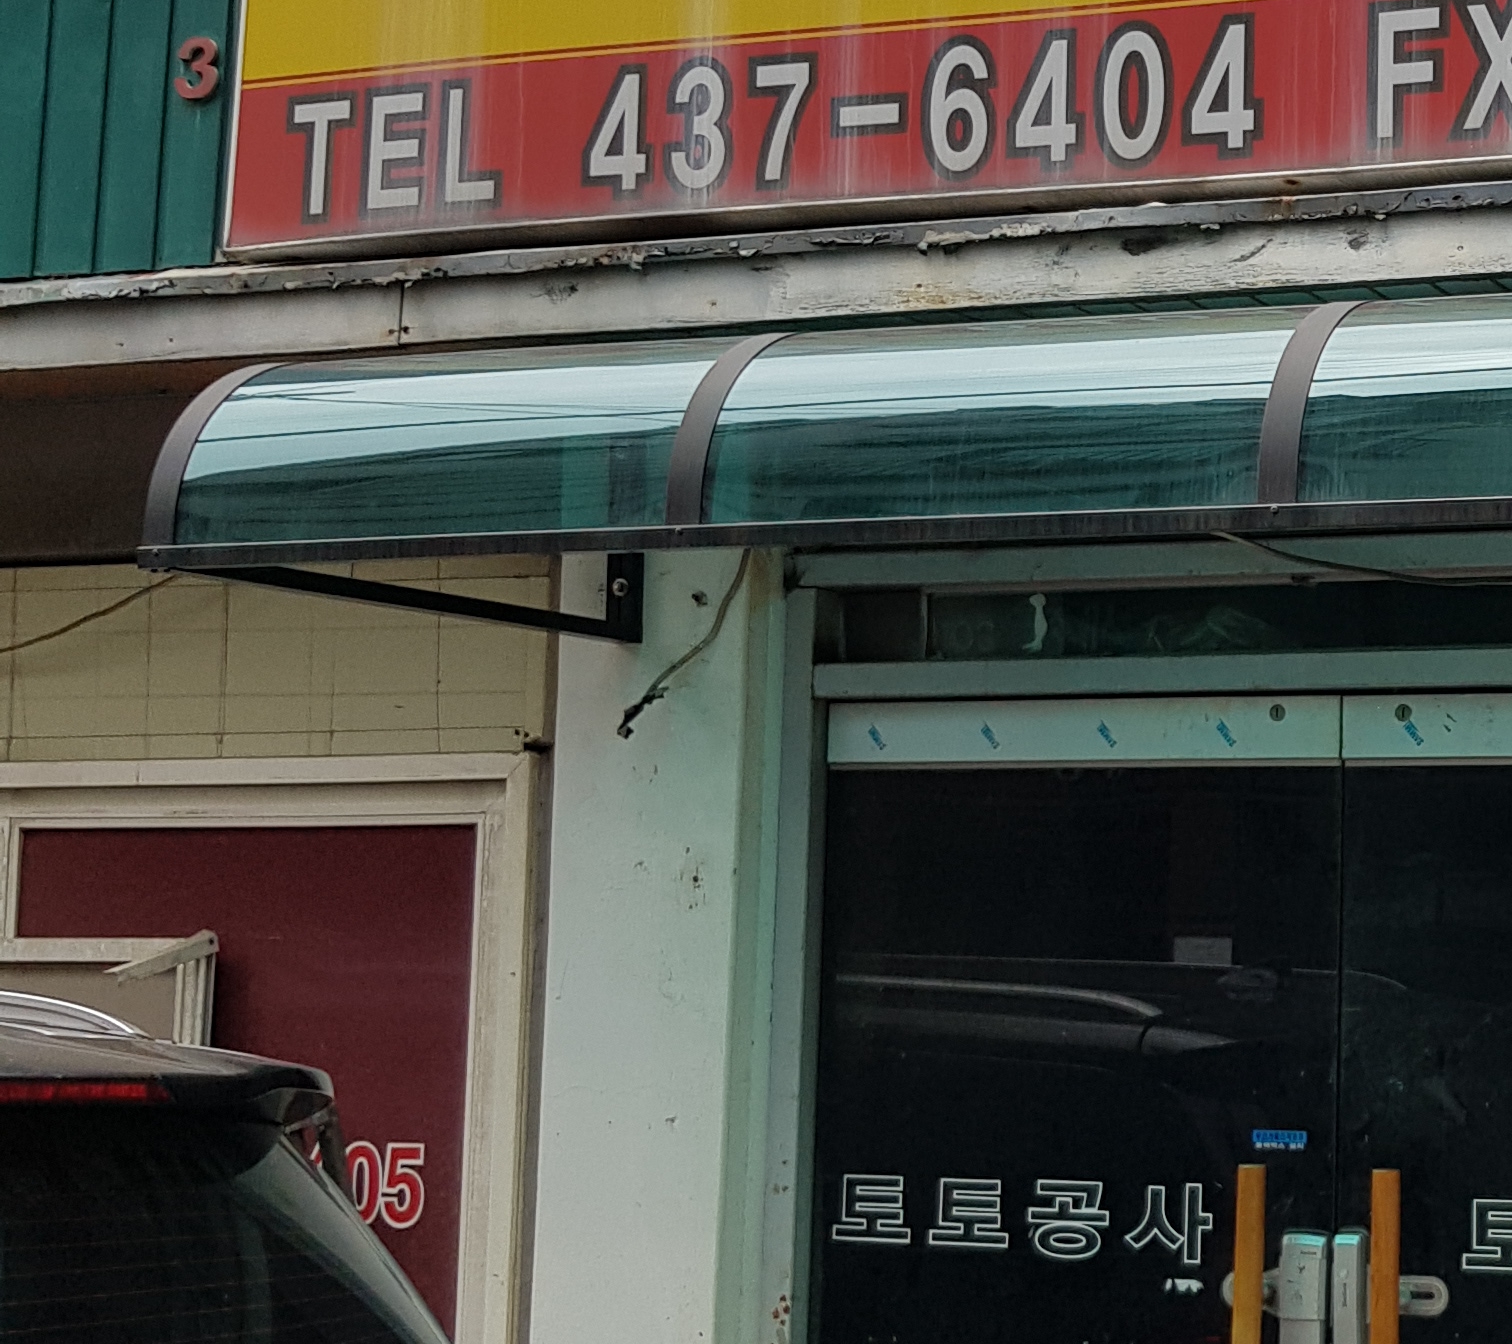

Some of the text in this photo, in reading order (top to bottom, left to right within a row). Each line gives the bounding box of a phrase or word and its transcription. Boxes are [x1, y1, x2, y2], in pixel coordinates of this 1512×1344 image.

[286, 75, 503, 225] TEL
[581, 11, 1264, 196] 437-6404
[830, 1171, 1214, 1267] 토토공사
